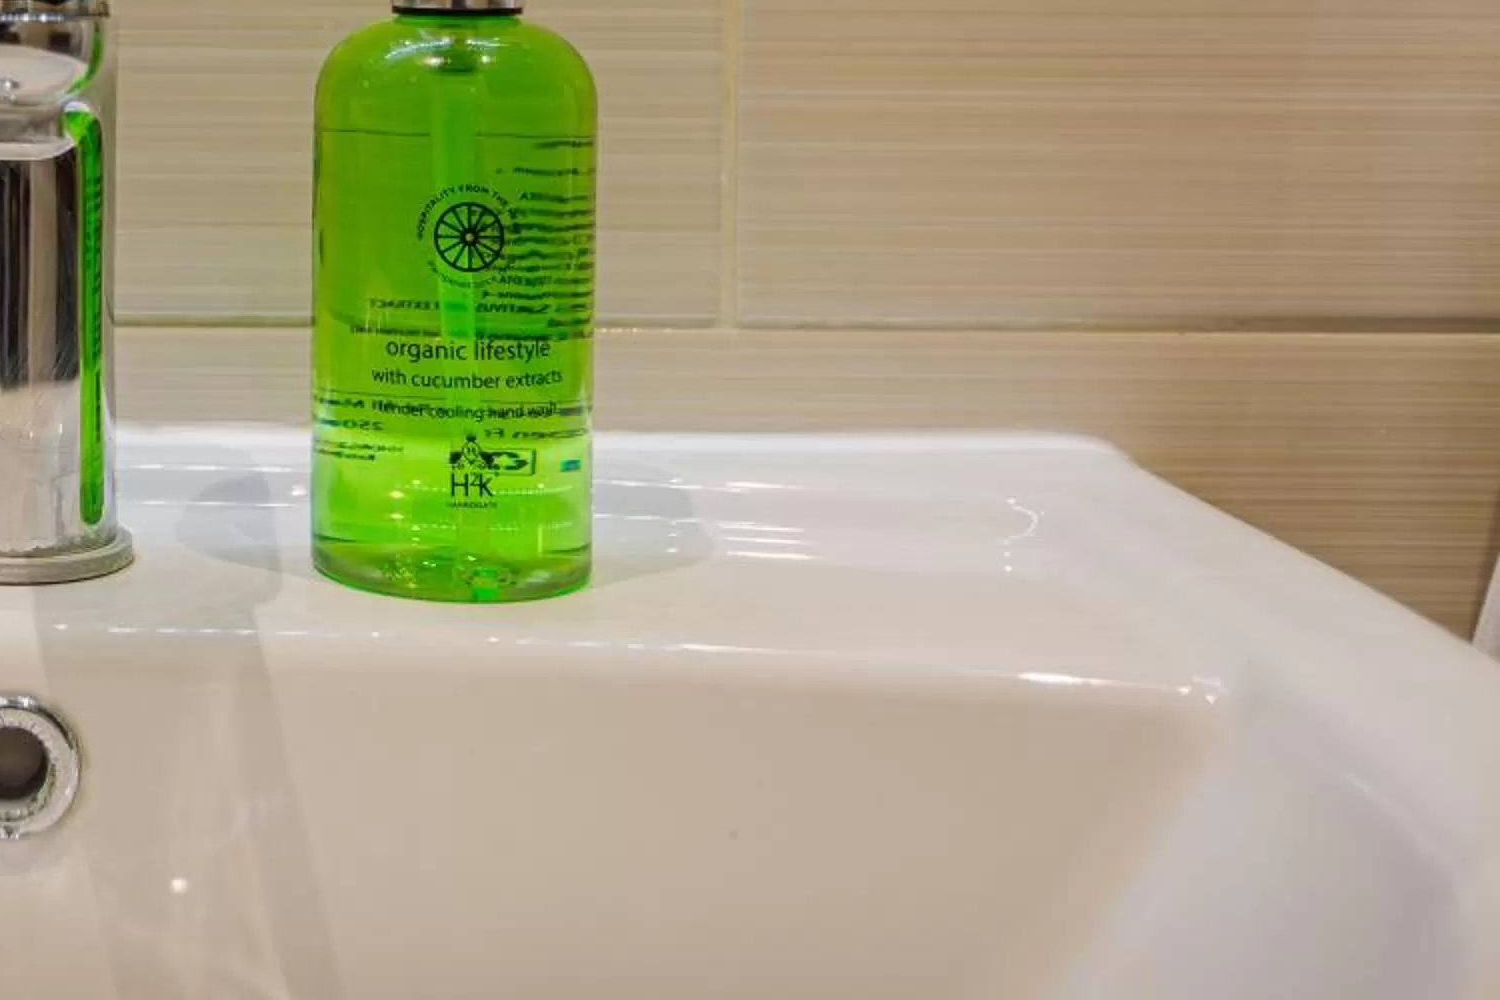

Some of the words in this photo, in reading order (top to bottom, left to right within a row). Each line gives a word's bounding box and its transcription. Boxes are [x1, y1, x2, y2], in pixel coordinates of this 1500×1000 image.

[386, 340, 468, 363] organic
[474, 338, 552, 364] lifestyle
[371, 368, 407, 386] with
[411, 372, 501, 389] cucumber
[505, 369, 563, 389] extracts
